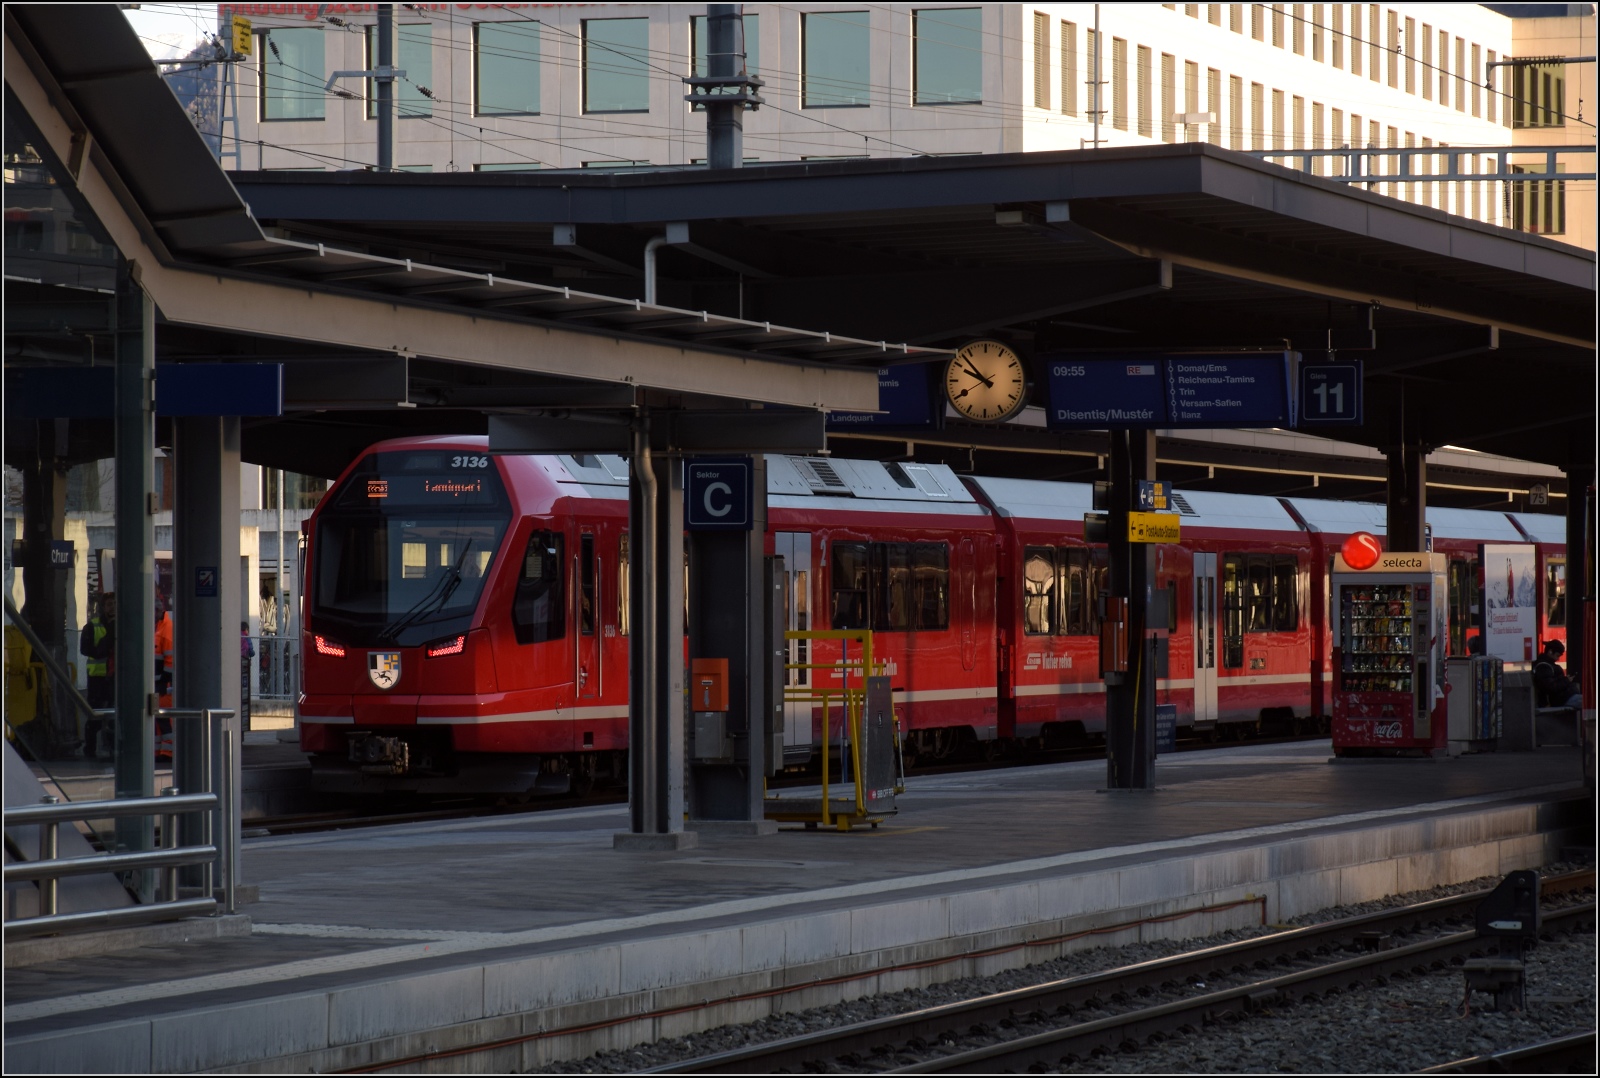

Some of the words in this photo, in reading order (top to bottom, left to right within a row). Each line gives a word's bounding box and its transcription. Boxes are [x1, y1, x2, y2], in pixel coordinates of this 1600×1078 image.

[1053, 366, 1086, 376] 09:55
[1128, 366, 1141, 374] RE
[1177, 364, 1228, 373] Domat/Ems
[1178, 376, 1255, 384] Reichenau-Tamins
[1179, 388, 1196, 396] Trin
[1180, 399, 1242, 407] Versam-Safien
[1312, 382, 1344, 414] 11
[831, 414, 874, 423] Landquart
[1057, 408, 1154, 422] Disentis/Mustér
[1181, 411, 1202, 419] Ilanz
[451, 456, 488, 468] 3136
[696, 471, 720, 479] Sektor
[703, 481, 732, 517] C
[1532, 492, 1545, 504] 75
[51, 549, 69, 563] Chur
[820, 539, 826, 567] 2
[1159, 549, 1164, 573] 2
[1382, 558, 1422, 568] selecta
